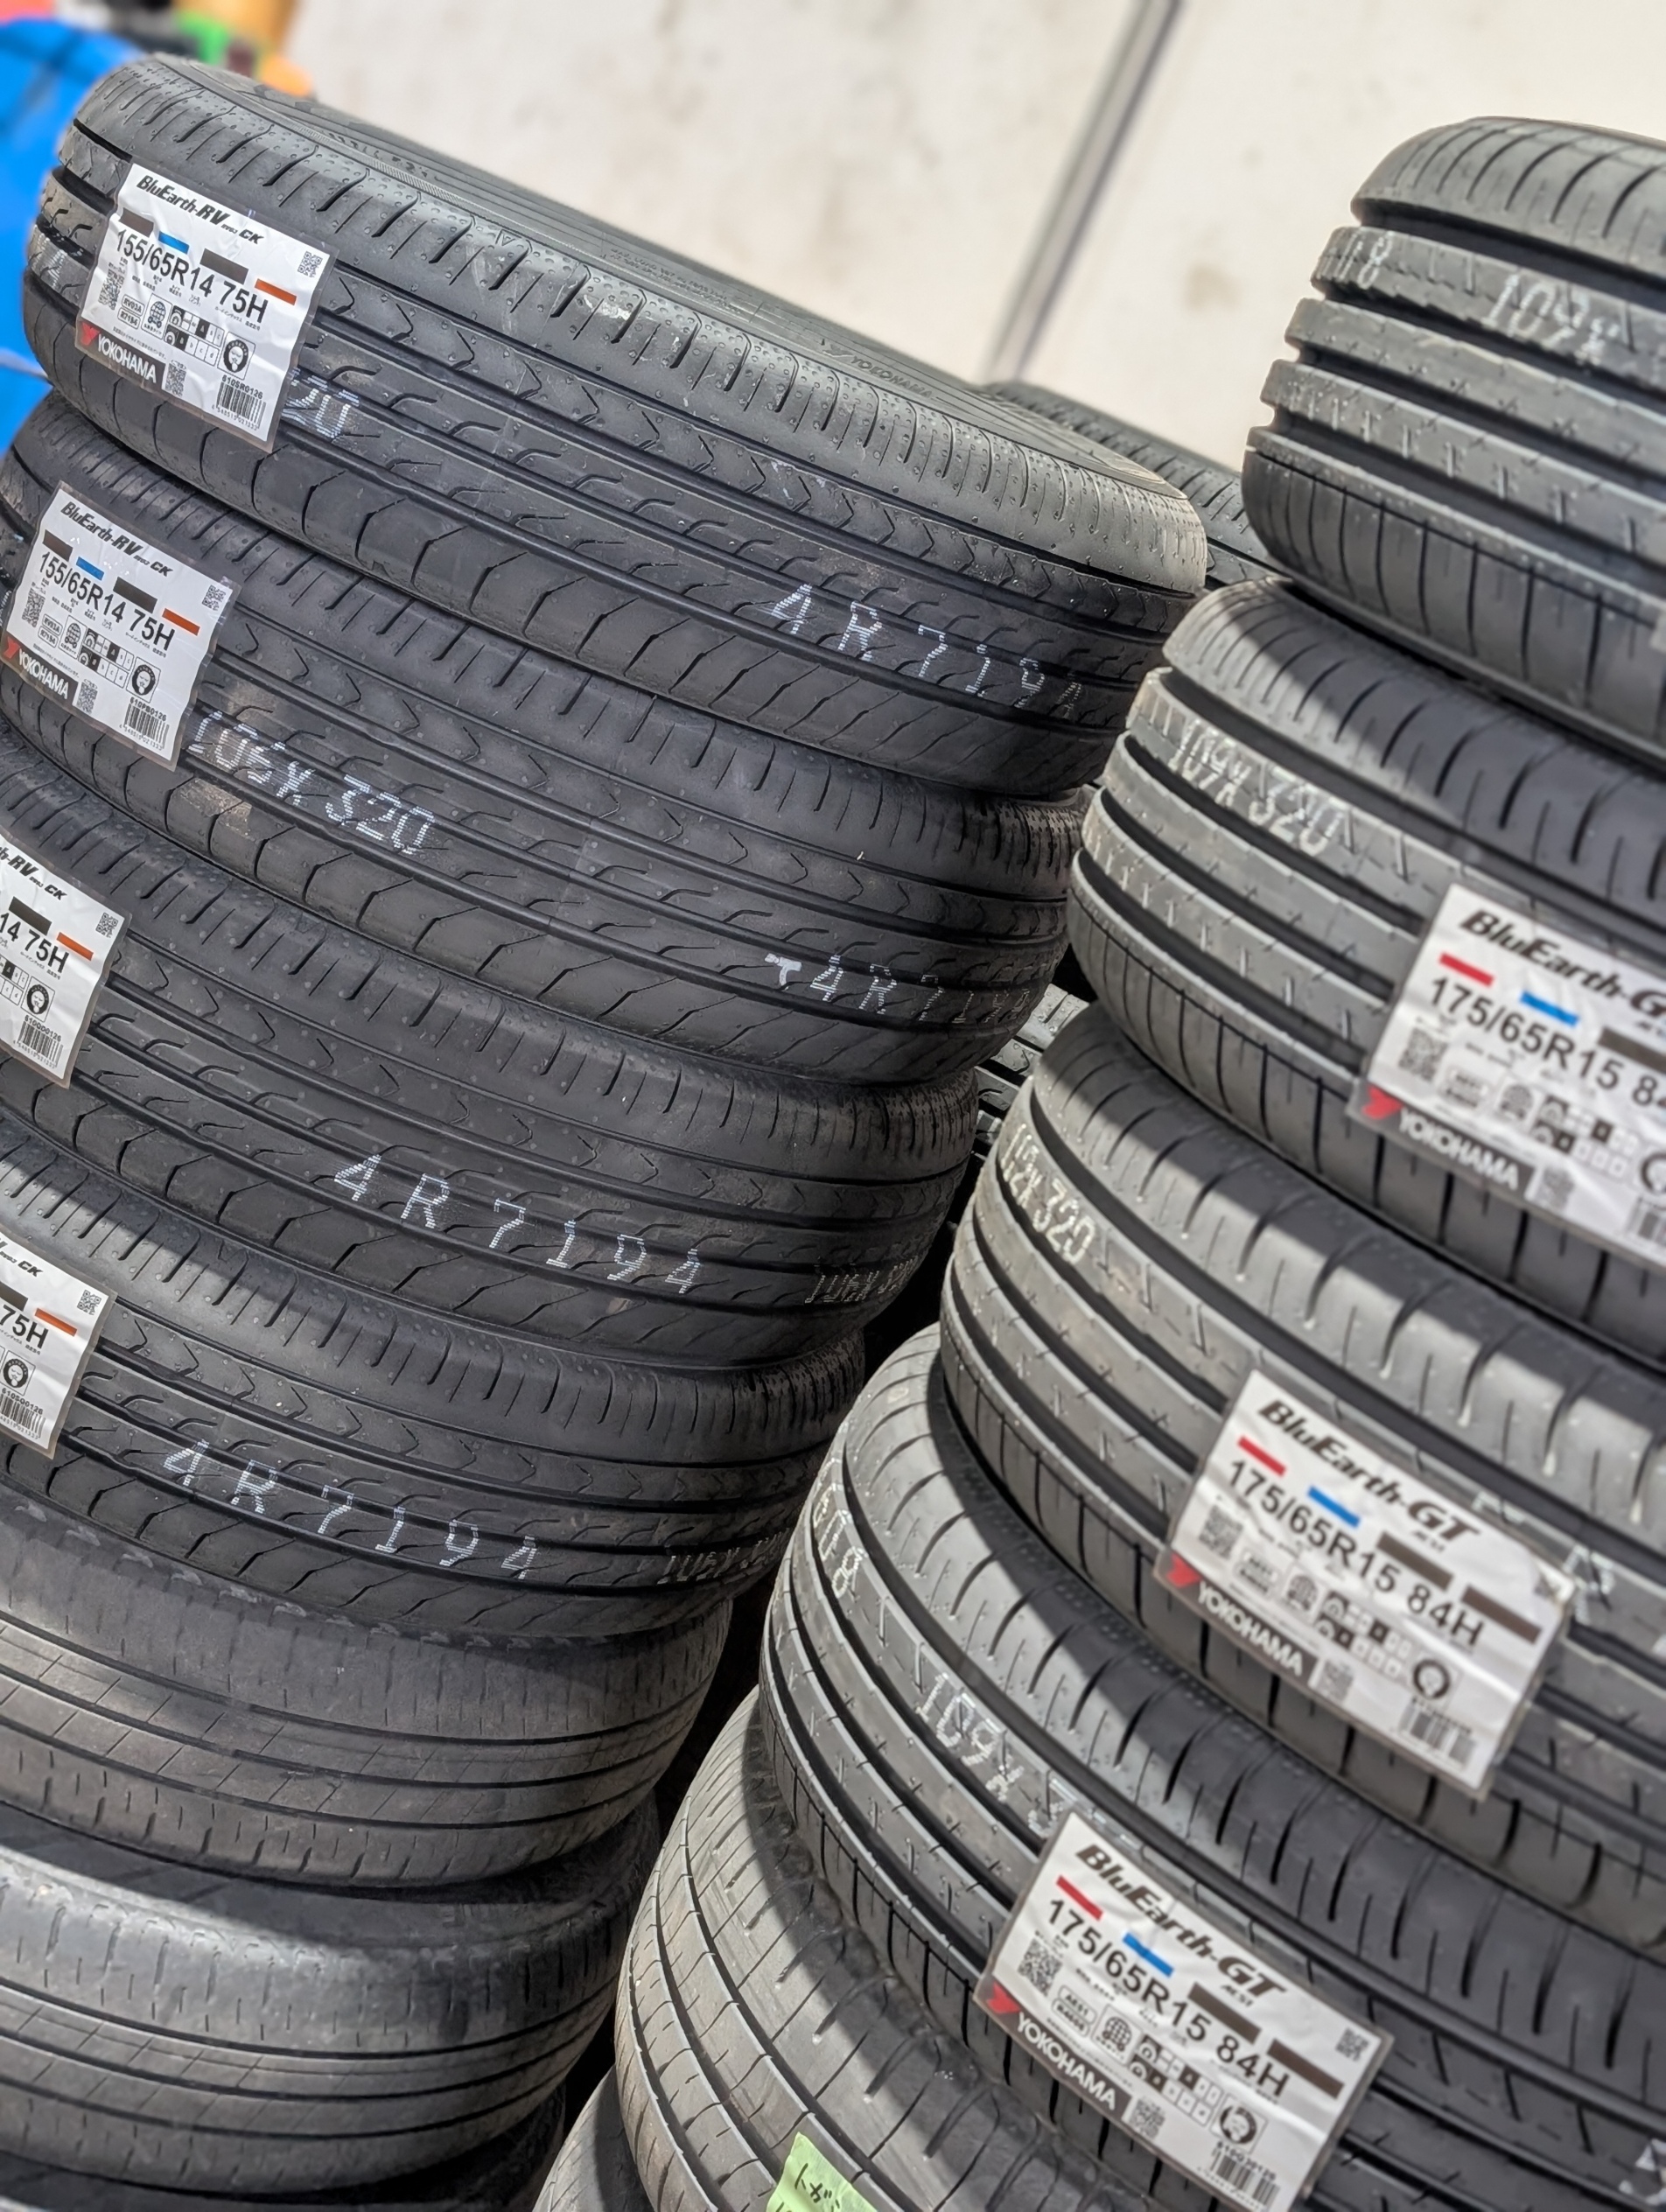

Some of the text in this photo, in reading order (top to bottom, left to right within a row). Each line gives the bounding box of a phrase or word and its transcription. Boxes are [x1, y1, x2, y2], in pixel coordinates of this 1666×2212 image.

[136, 175, 231, 226] BluEarth-RV
[238, 228, 264, 245] CK
[116, 228, 215, 298] 155/65R14
[219, 281, 269, 324] 75H
[96, 333, 157, 383] YOKOHAMA
[60, 501, 144, 556] BluEarth-RV
[150, 561, 173, 577] CK
[41, 551, 126, 623] 155/65R14
[129, 609, 175, 651] 75H
[18, 648, 69, 700] YOKOHAMA
[326, 774, 436, 854] 320
[44, 885, 67, 900] CK
[24, 928, 69, 973] 75H
[1429, 976, 1666, 1107] 175/65R15 8
[1399, 1108, 1520, 1190] YOKOHAMA
[1032, 1179, 1095, 1264] 320
[18, 1260, 44, 1277] CK
[1258, 1398, 1481, 1544] BluEarth-GT
[1228, 1459, 1403, 1592] 175/65R15
[1406, 1584, 1486, 1647] 84H
[1197, 1581, 1304, 1677] YOKOHAMA
[1075, 1844, 1287, 2000] BluEarth-GT
[1047, 1898, 1212, 2043] 175/65R15
[1216, 2034, 1292, 2097] 84H
[1017, 2012, 1117, 2110] YOKOHAMA
